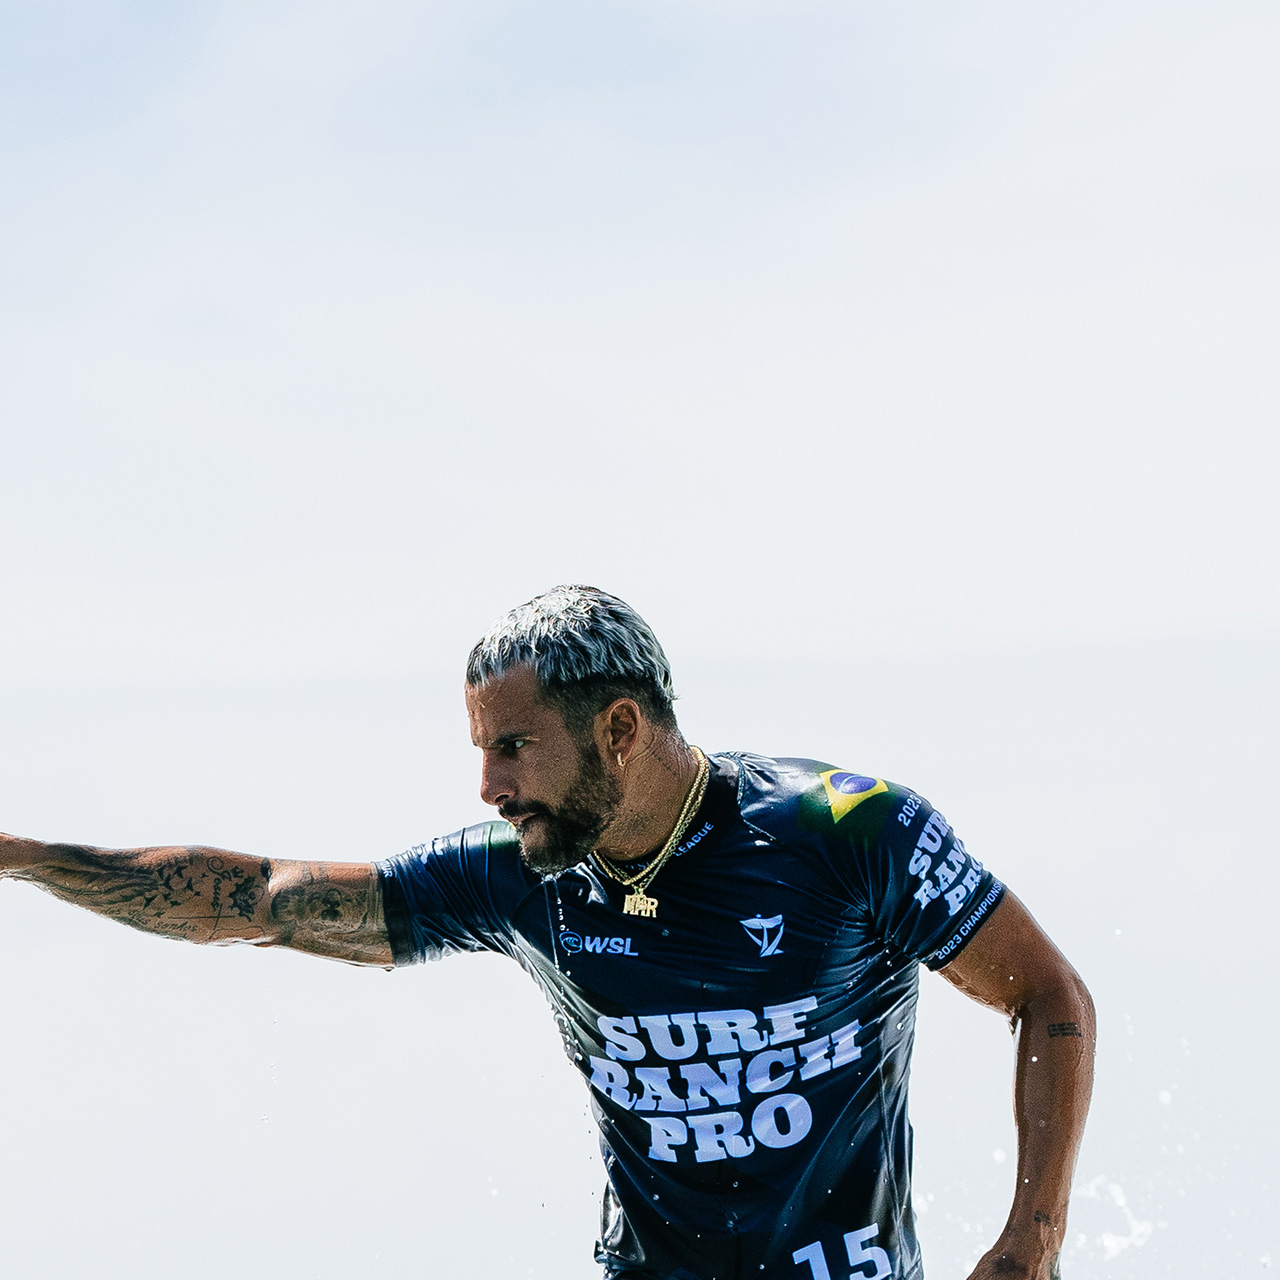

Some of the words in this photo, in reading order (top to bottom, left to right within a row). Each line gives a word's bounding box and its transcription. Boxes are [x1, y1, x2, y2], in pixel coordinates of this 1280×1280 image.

[672, 821, 715, 857] LEAGUE
[897, 794, 922, 827] 2023
[908, 810, 951, 880] SUR
[913, 838, 967, 910] RAN
[584, 935, 639, 956] WSL
[936, 936, 963, 960] 2023
[959, 880, 1004, 936] CHAMPIONS
[597, 996, 818, 1061] SURF
[590, 1019, 862, 1112] RANCH
[641, 1093, 813, 1163] PRO
